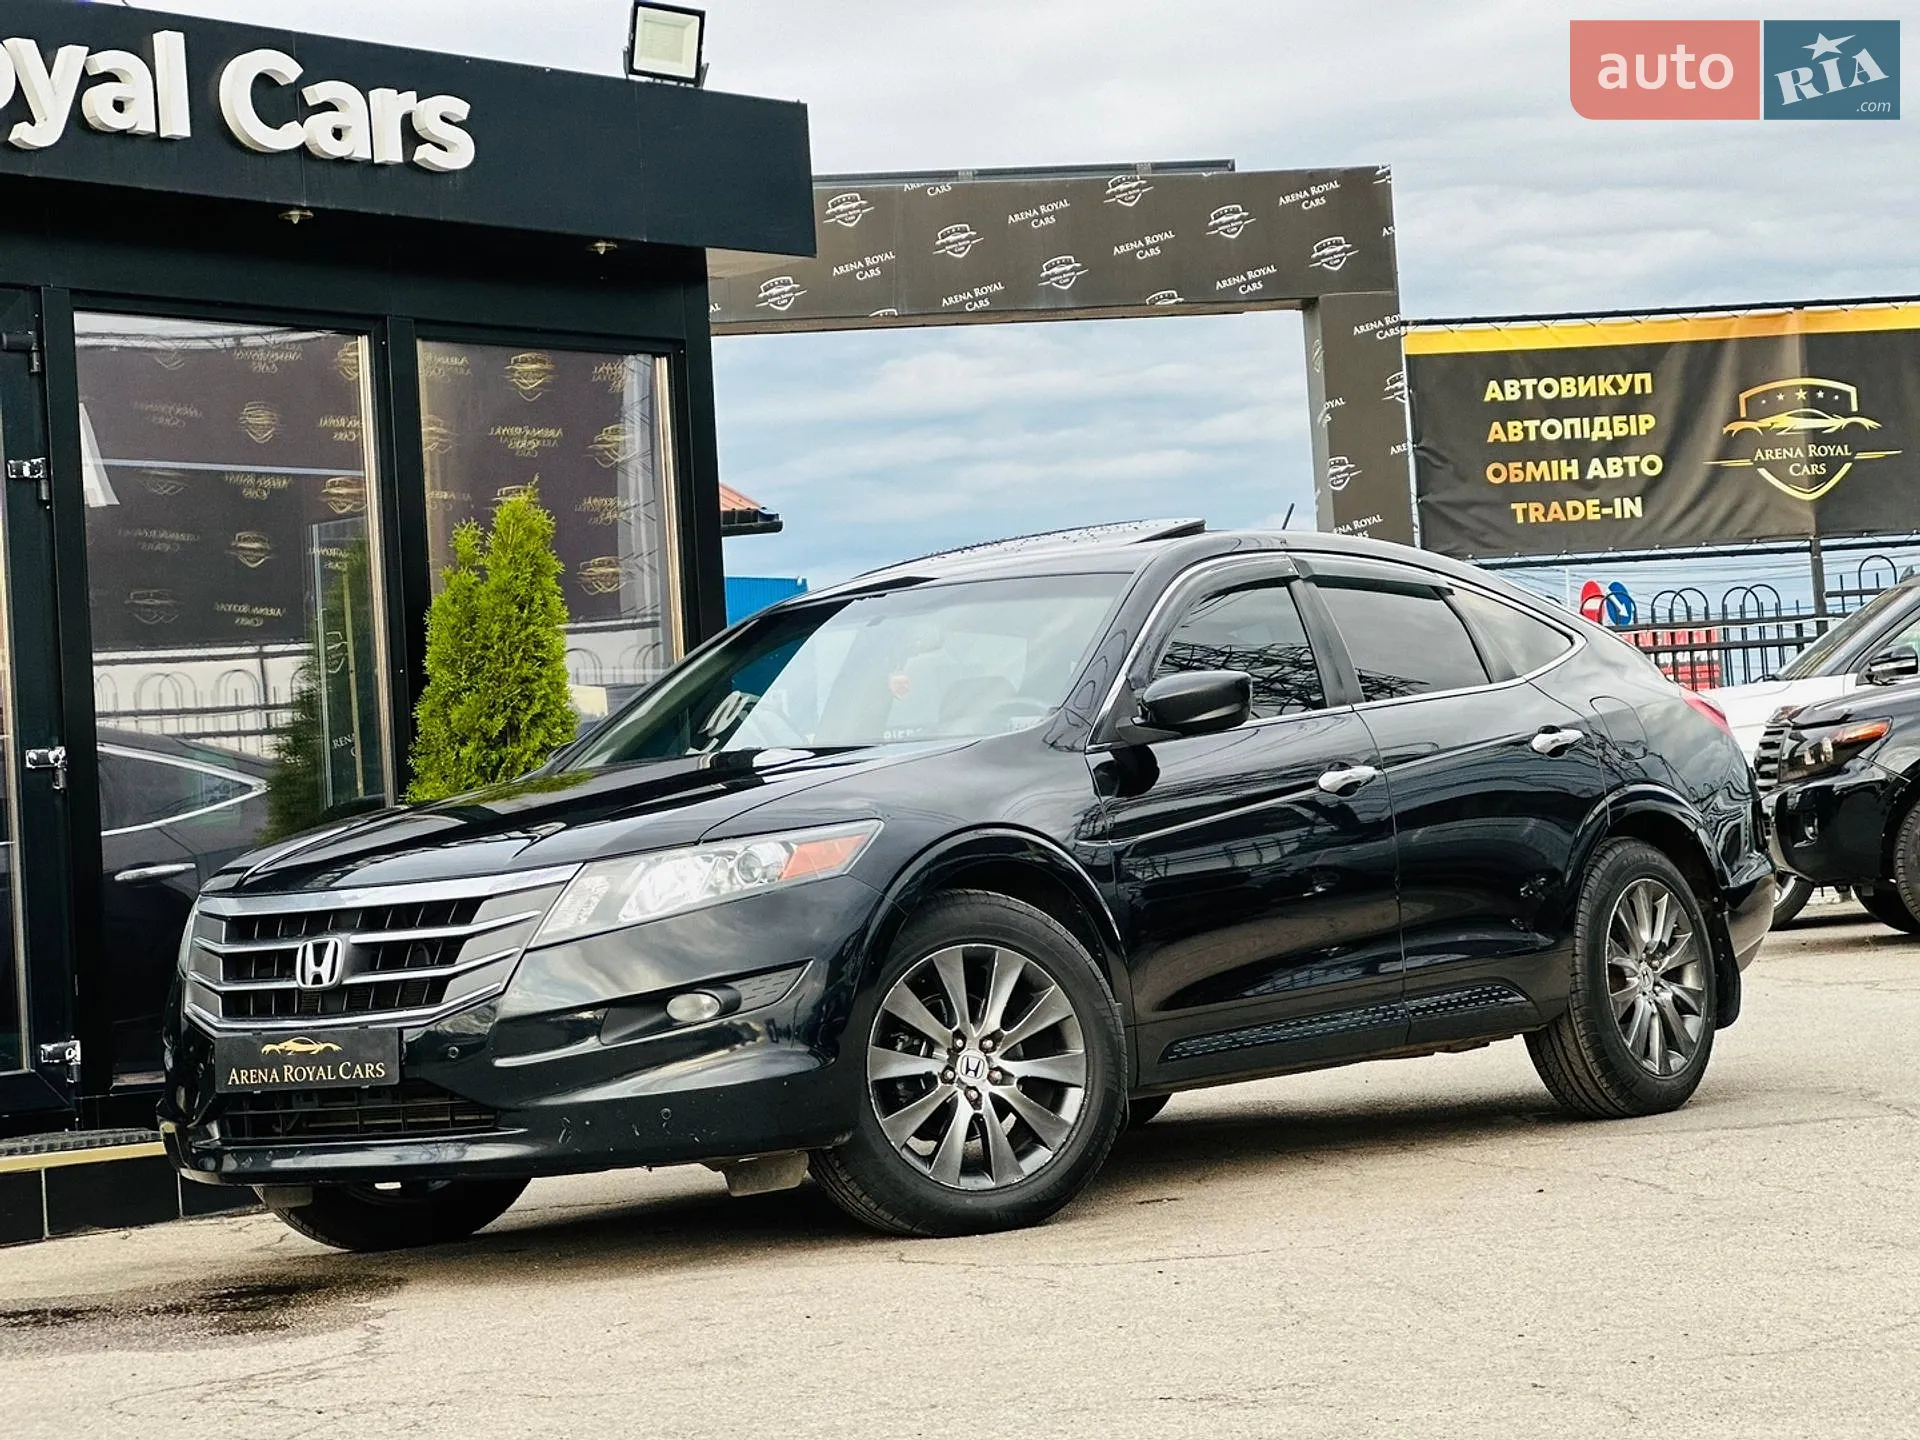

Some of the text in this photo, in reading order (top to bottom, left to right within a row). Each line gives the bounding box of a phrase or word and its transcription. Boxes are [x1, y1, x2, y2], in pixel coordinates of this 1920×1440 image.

[0, 29, 476, 173] yal Cars
[1278, 179, 1341, 207] ARENA ROYAL
[1301, 196, 1326, 210] CARS
[1007, 198, 1071, 225] ARENA ROYAL
[1031, 215, 1056, 229] CARS
[1113, 229, 1176, 256] ARENA ROYAL
[1136, 246, 1161, 260] CARS
[832, 250, 896, 277] ARENA ROYAL
[855, 267, 881, 281] CARS
[1215, 264, 1278, 291] ARENA ROYAL
[1238, 280, 1263, 295] CARS
[941, 281, 1005, 307] ARENA ROYAL
[965, 298, 991, 312] CARS
[1353, 319, 1384, 336] ARENA
[1483, 372, 1653, 402] АВТОВИКУП
[1487, 413, 1656, 443] АВТОПІДБІР
[1754, 443, 1852, 462] ARENA ROYAL
[1486, 454, 1663, 484] ОБМІН АВТО
[1788, 462, 1827, 476] CARS
[1353, 514, 1384, 529] ROYAL
[1510, 496, 1644, 524] TRADE-IN
[227, 1061, 386, 1086] ARENA ROYAL CARS
